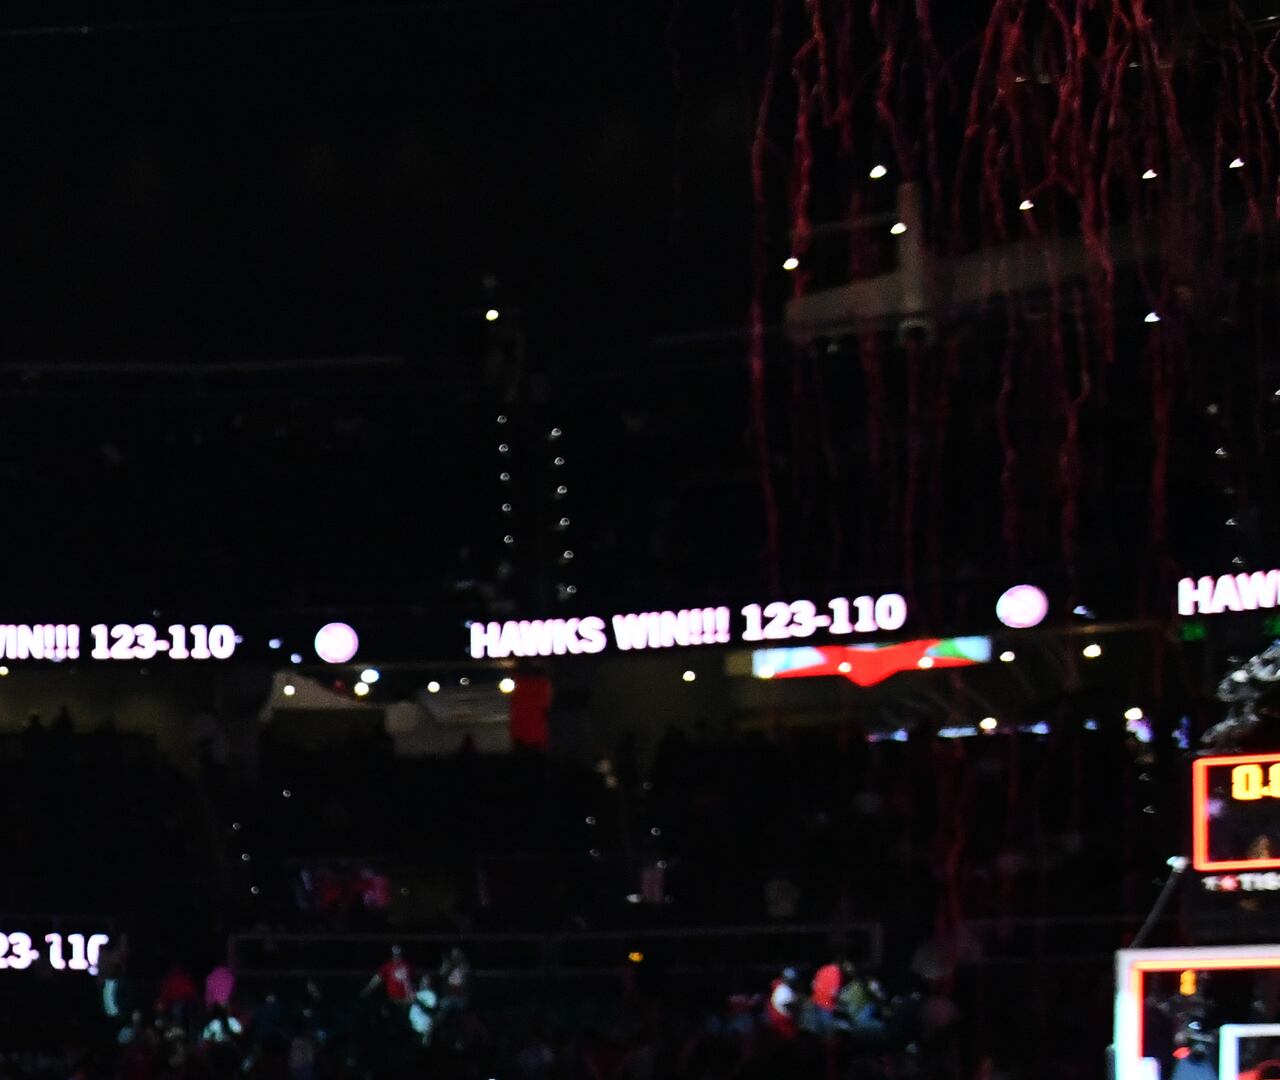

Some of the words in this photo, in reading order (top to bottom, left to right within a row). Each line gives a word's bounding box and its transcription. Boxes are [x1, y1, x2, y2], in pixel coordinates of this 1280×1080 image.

[1177, 568, 1280, 616] HAW
[90, 624, 237, 660] 123-110
[469, 617, 607, 659] HAWKS
[612, 606, 731, 651] WIN!!!
[740, 593, 908, 641] 123-110
